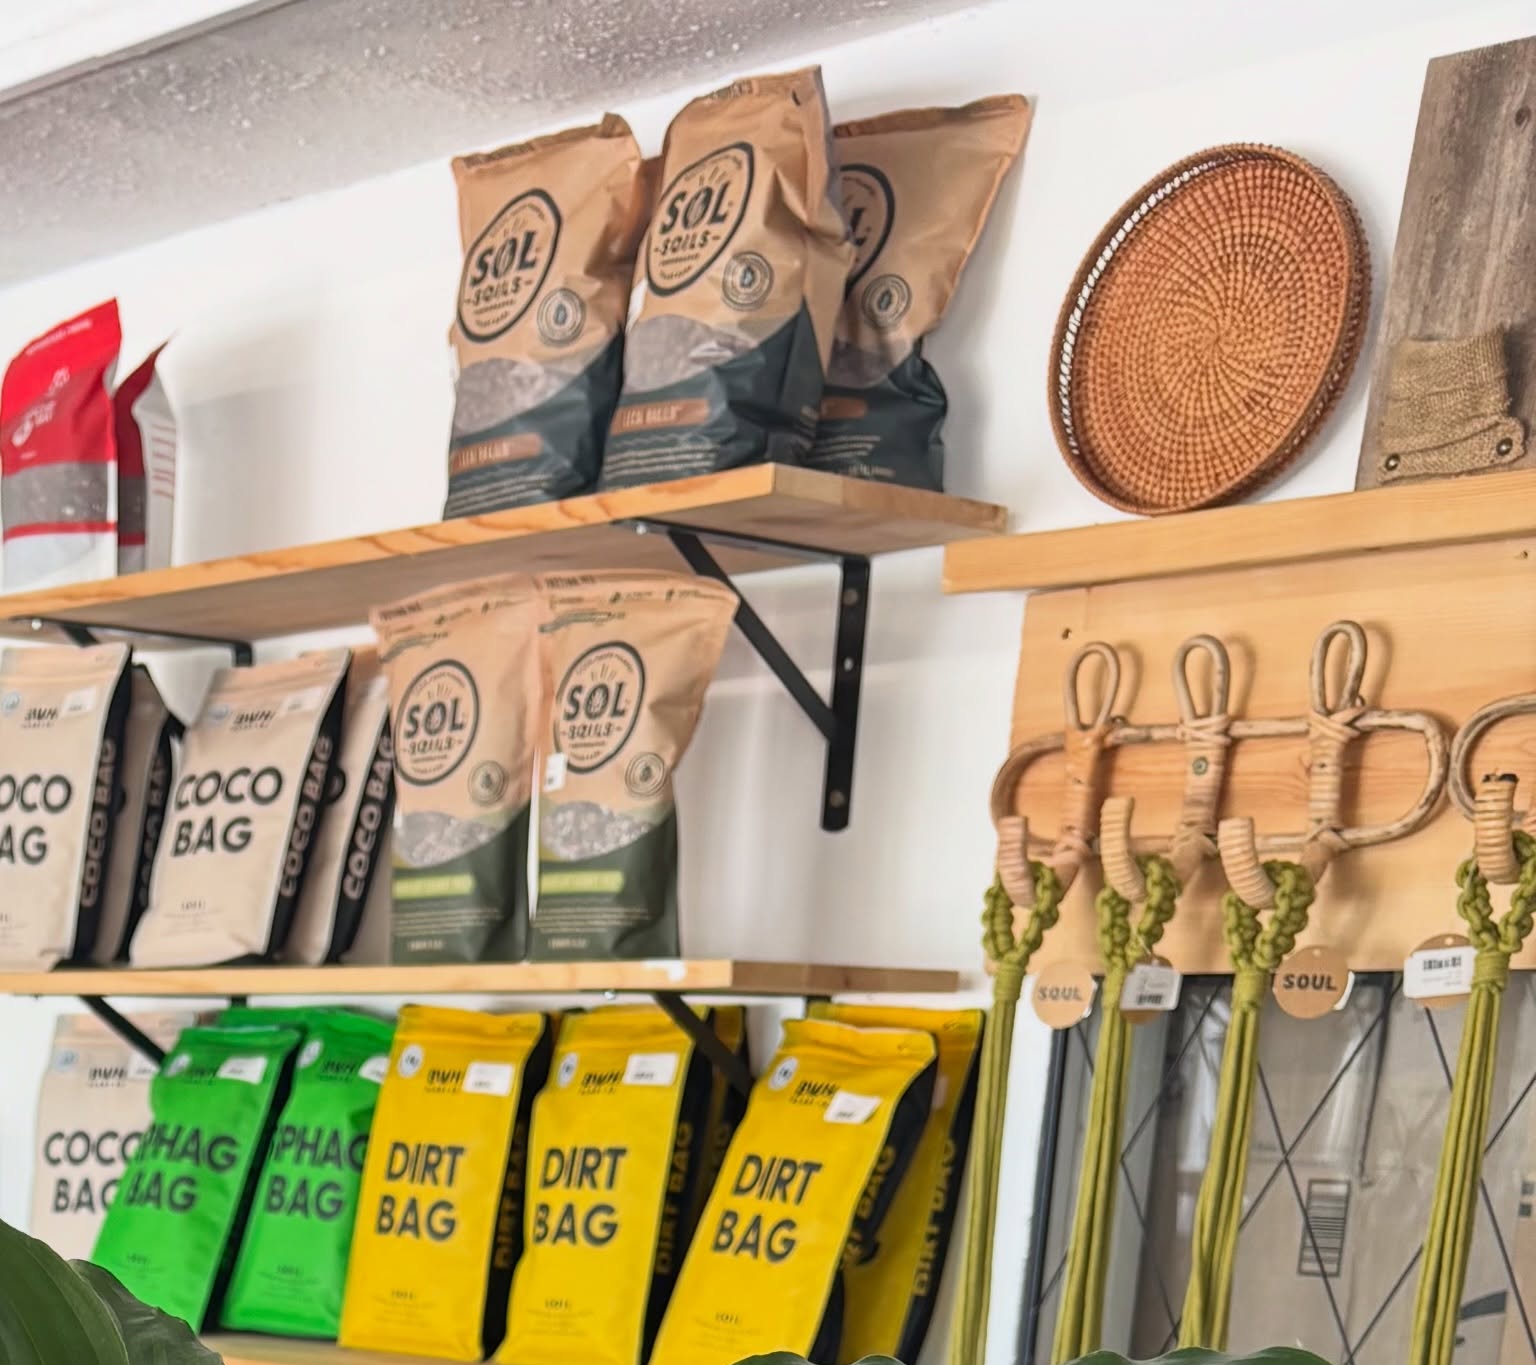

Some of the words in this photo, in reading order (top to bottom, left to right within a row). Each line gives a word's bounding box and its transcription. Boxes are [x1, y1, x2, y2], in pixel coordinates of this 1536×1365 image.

[660, 181, 730, 235] SOL
[469, 230, 536, 287] SOL
[404, 698, 464, 738] SOL
[566, 681, 627, 721] SOL
[174, 766, 283, 812] COCO
[171, 816, 253, 857] BAG
[280, 803, 316, 897] COCO
[303, 737, 331, 801] BAG
[344, 801, 381, 899] COCO
[365, 736, 394, 800] BAG
[1037, 986, 1083, 1002] SOUL
[1282, 973, 1338, 992] SOUL
[385, 1141, 466, 1188] DIRT
[539, 1146, 628, 1191] DIRT
[731, 1153, 823, 1207] DIRT
[264, 1174, 345, 1221] BAG
[375, 1194, 457, 1243] BAG
[533, 1203, 619, 1247] BAG
[710, 1208, 797, 1264] BAG
